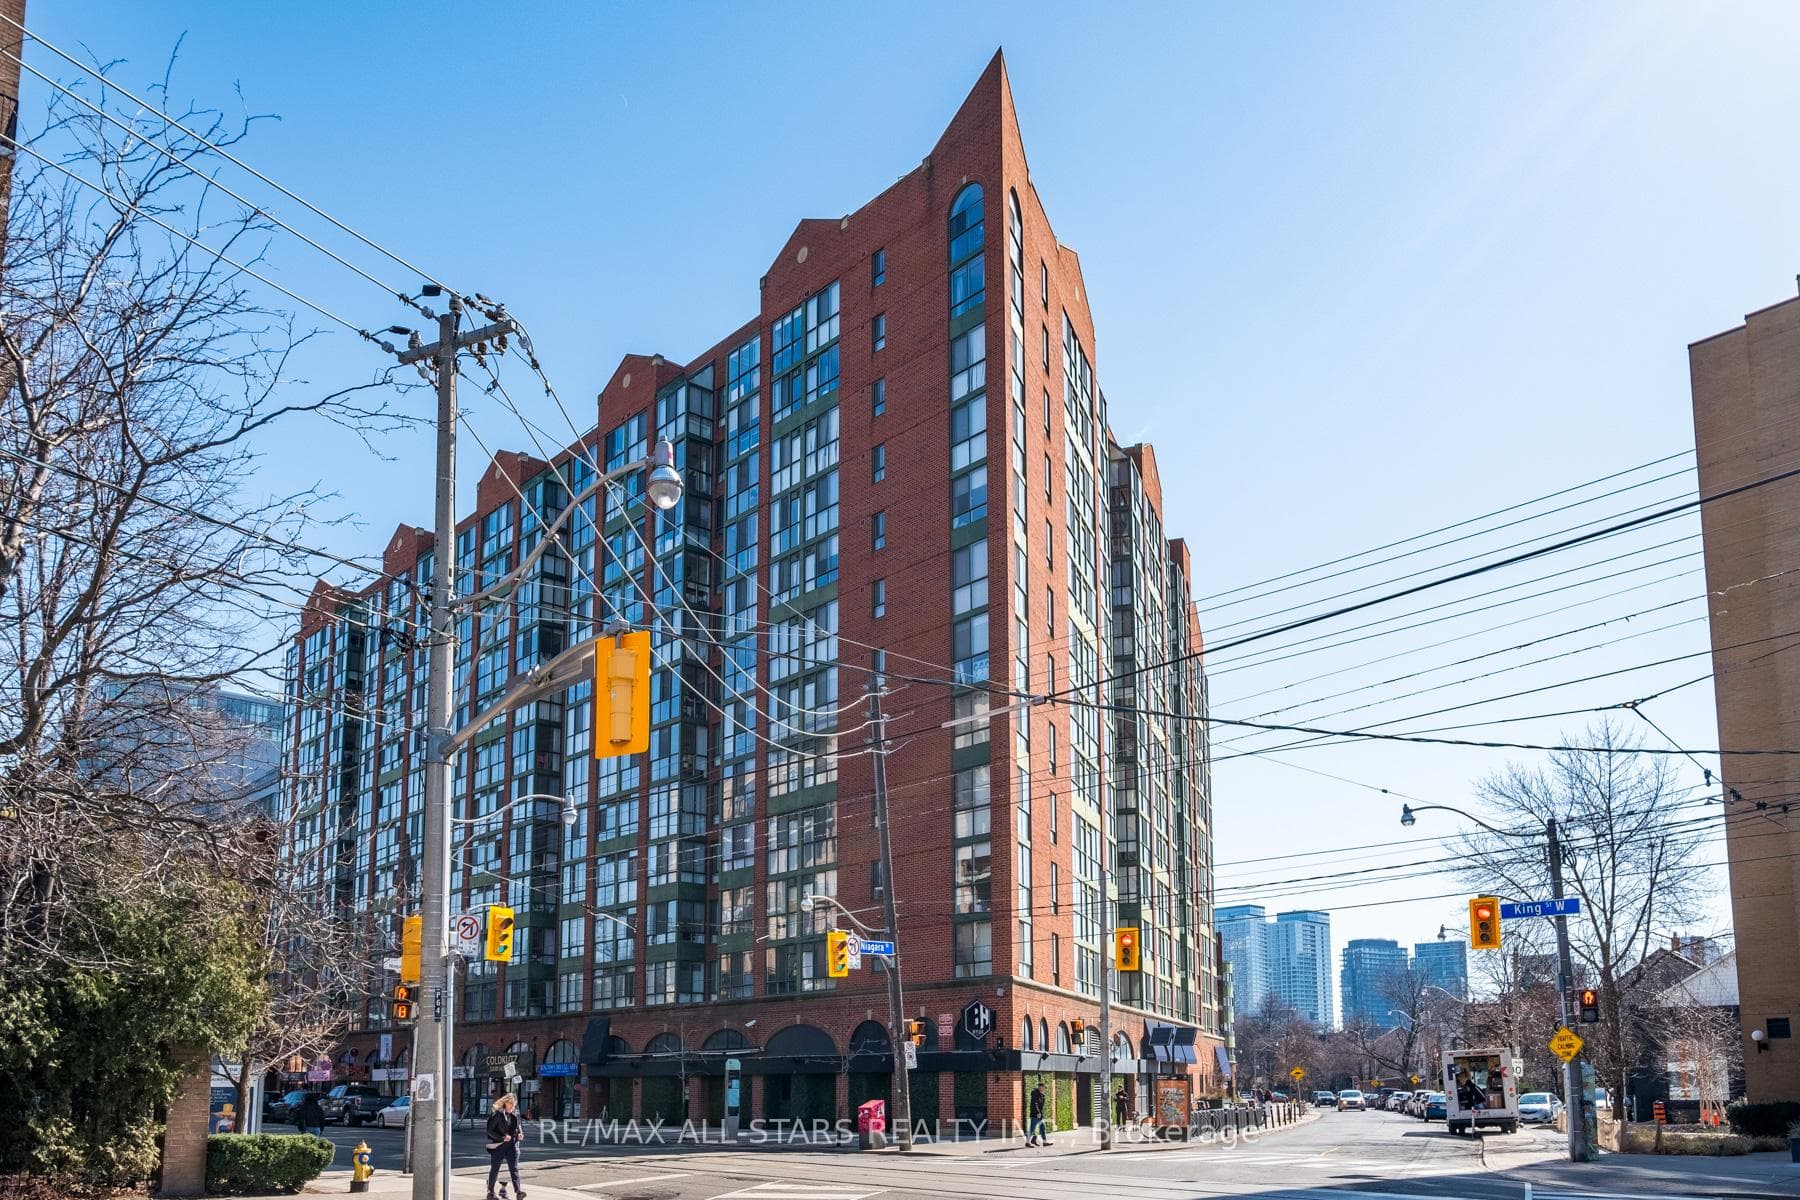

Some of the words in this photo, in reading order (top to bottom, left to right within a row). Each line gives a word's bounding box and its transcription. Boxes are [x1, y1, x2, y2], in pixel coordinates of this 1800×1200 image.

[1514, 903, 1542, 916] King
[1555, 900, 1565, 911] W
[860, 942, 885, 954] Niagara
